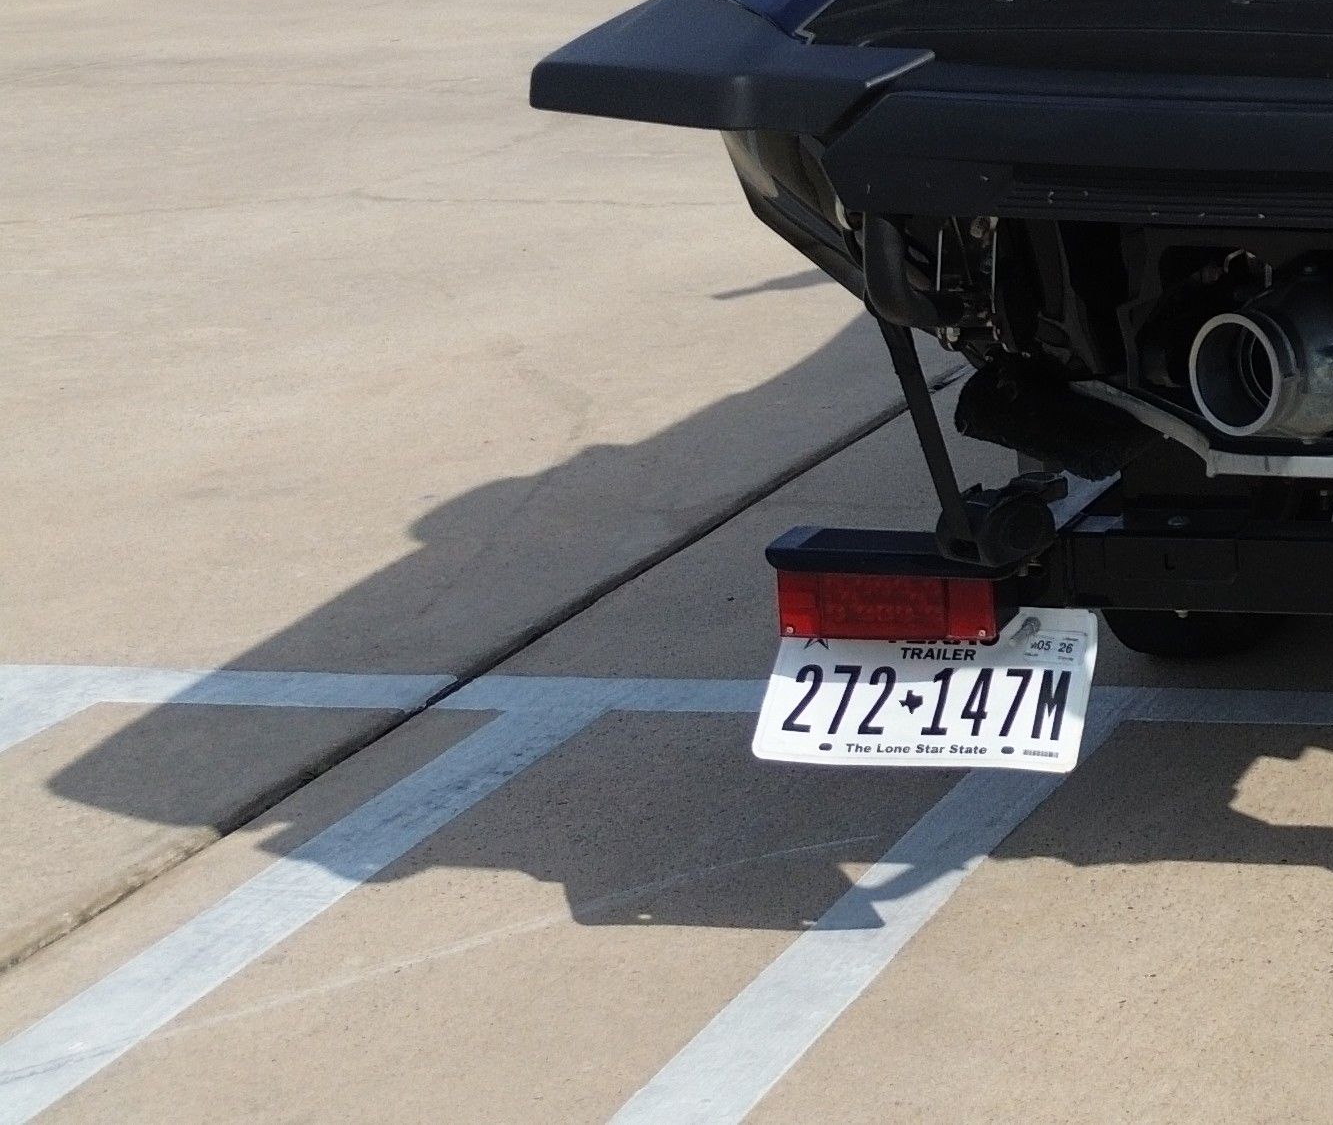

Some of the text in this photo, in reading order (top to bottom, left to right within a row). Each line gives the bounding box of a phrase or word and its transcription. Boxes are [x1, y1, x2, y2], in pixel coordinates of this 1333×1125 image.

[900, 647, 977, 661] TRAILER
[1037, 640, 1074, 654] 05 26
[781, 663, 1072, 741] 272 147M
[846, 743, 988, 755] The Lone Star State
